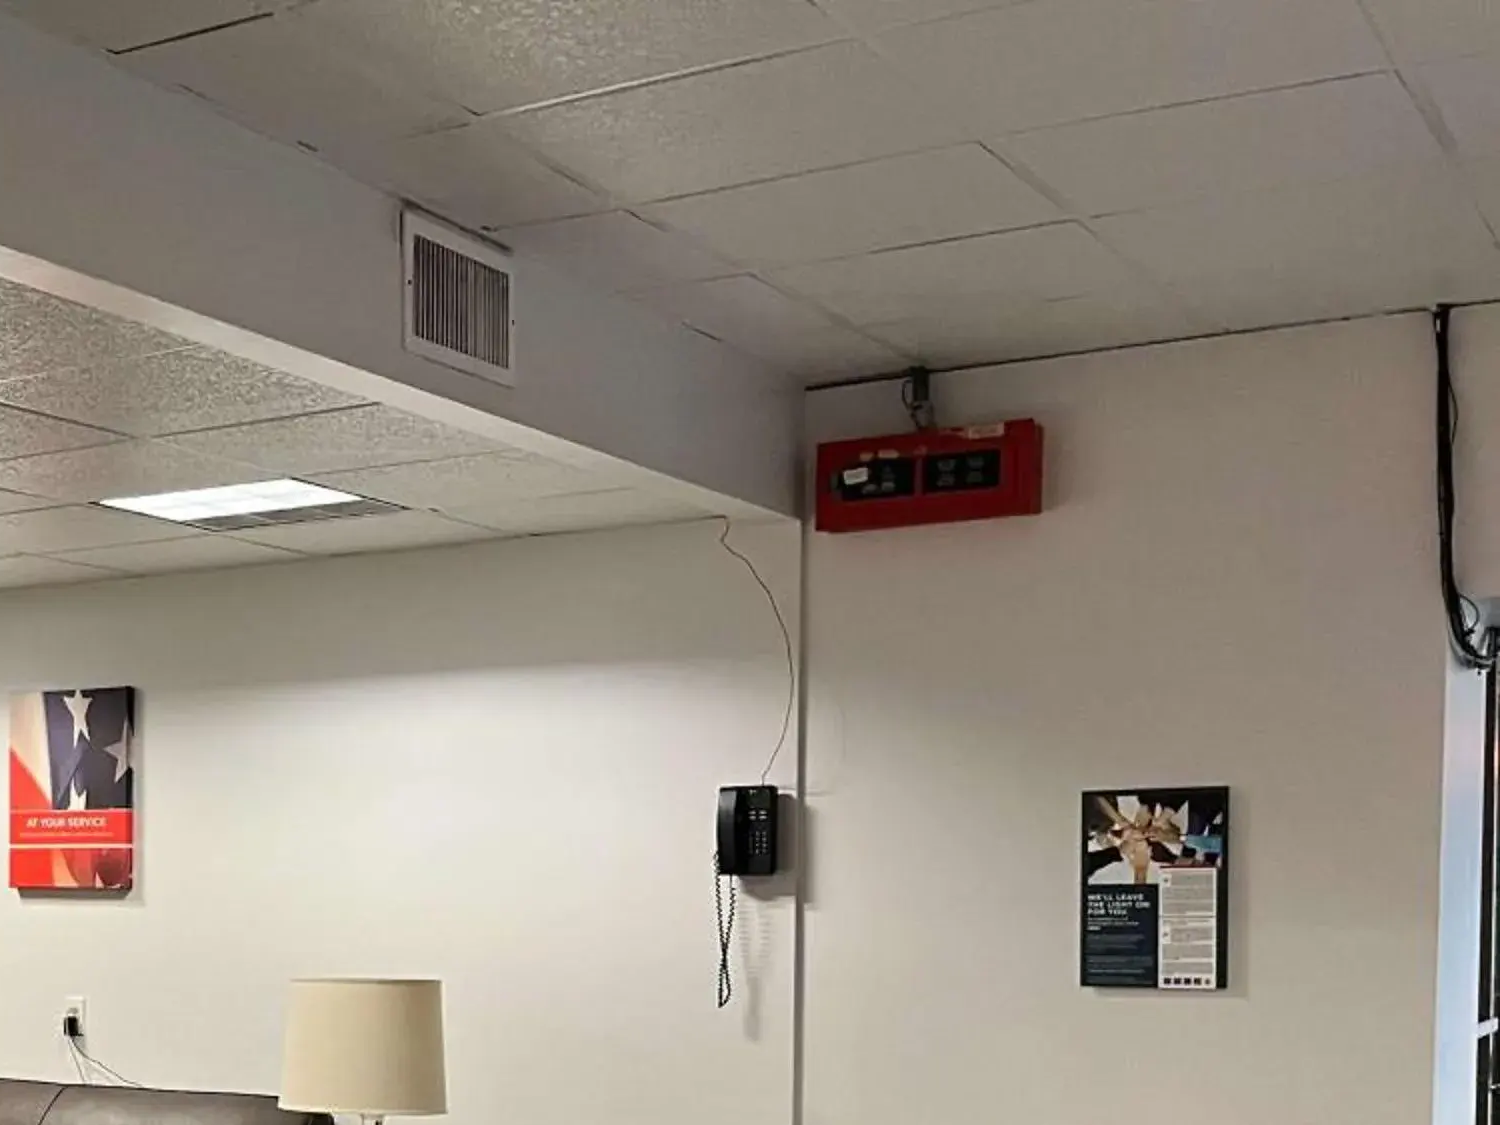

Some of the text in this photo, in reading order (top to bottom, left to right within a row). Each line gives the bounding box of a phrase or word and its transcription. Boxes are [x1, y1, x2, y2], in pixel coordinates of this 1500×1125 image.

[27, 816, 107, 828] AT YOUR SERVICE
[1087, 892, 1144, 901] WE'LL LEAVE
[1087, 901, 1151, 909] THE LIGHT ON
